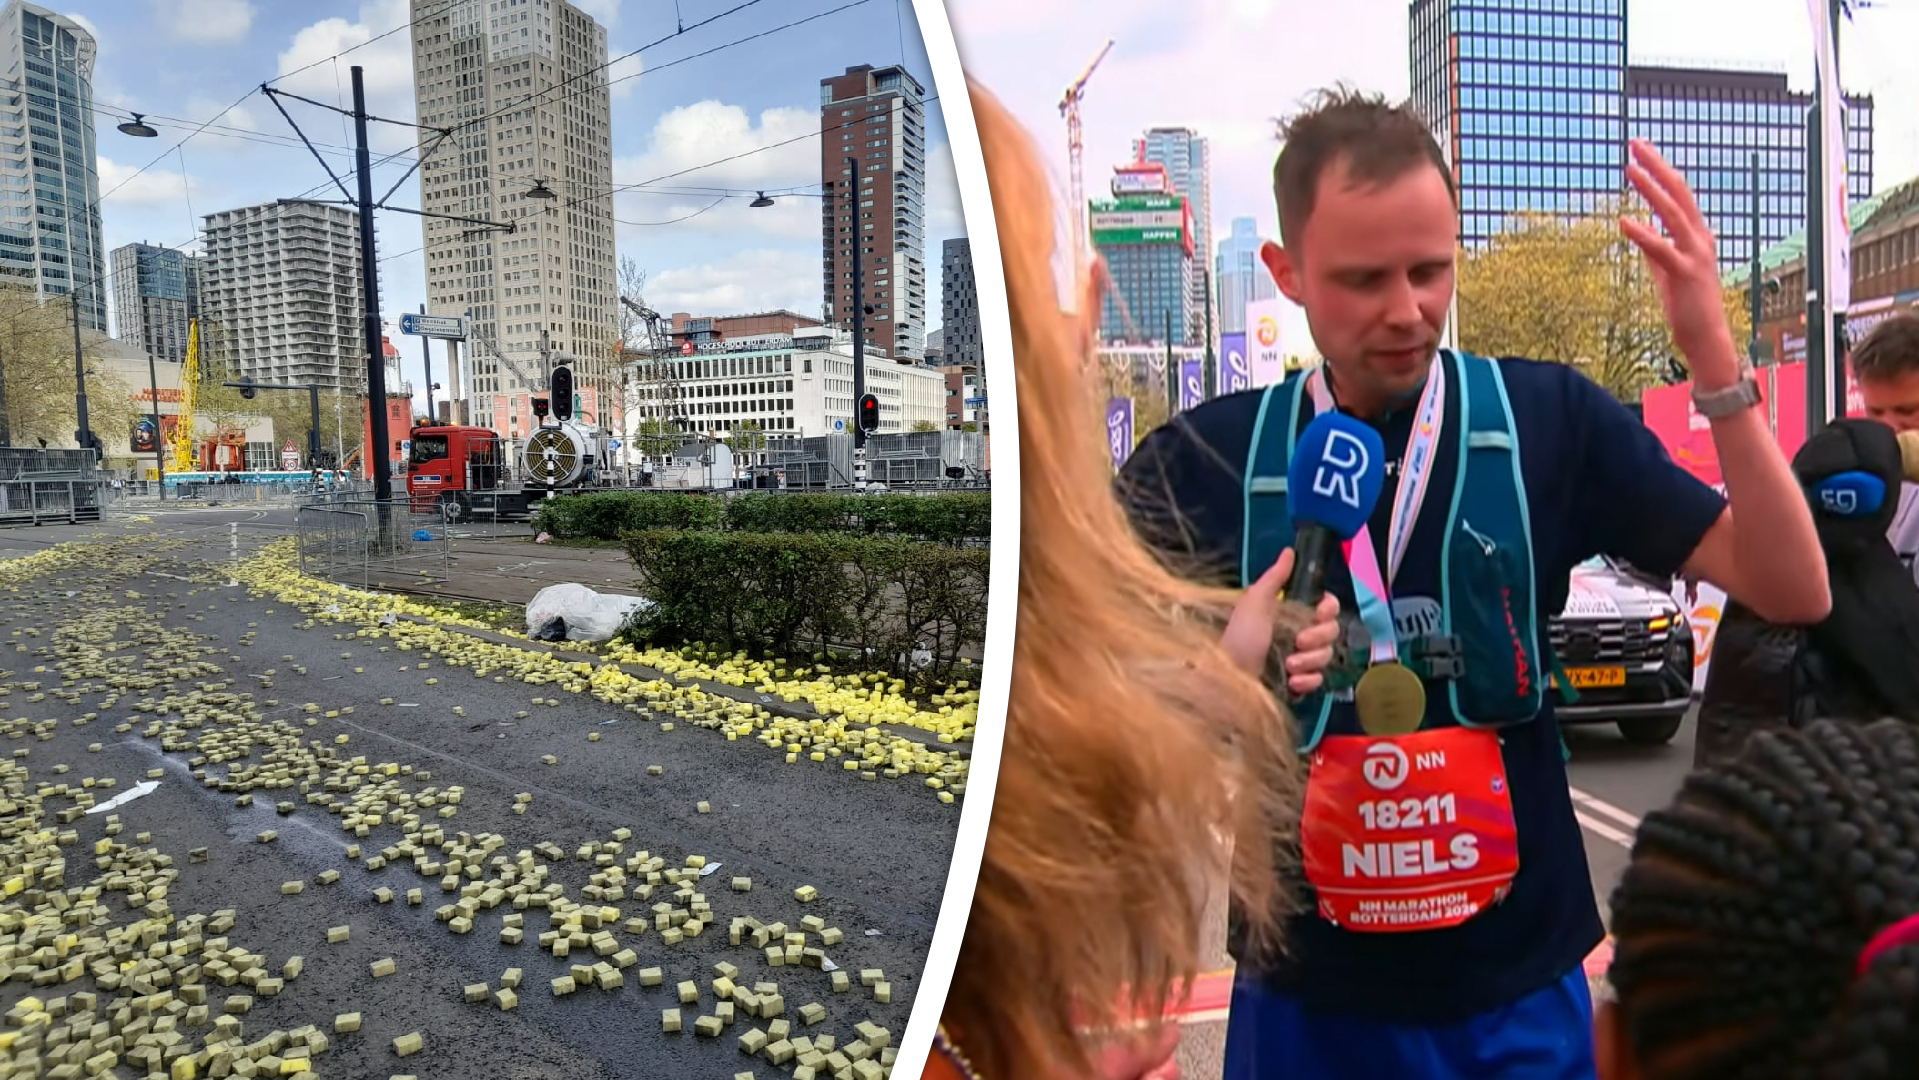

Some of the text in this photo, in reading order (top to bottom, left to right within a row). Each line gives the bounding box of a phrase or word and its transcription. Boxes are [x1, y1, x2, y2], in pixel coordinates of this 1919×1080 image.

[746, 336, 793, 347] ROTERDAM
[1416, 751, 1446, 771] NN
[1358, 793, 1457, 830] 18211
[1342, 833, 1480, 878] NIELS
[1384, 892, 1468, 912] MARATHON
[1350, 908, 1442, 925] ROTTERDAM
